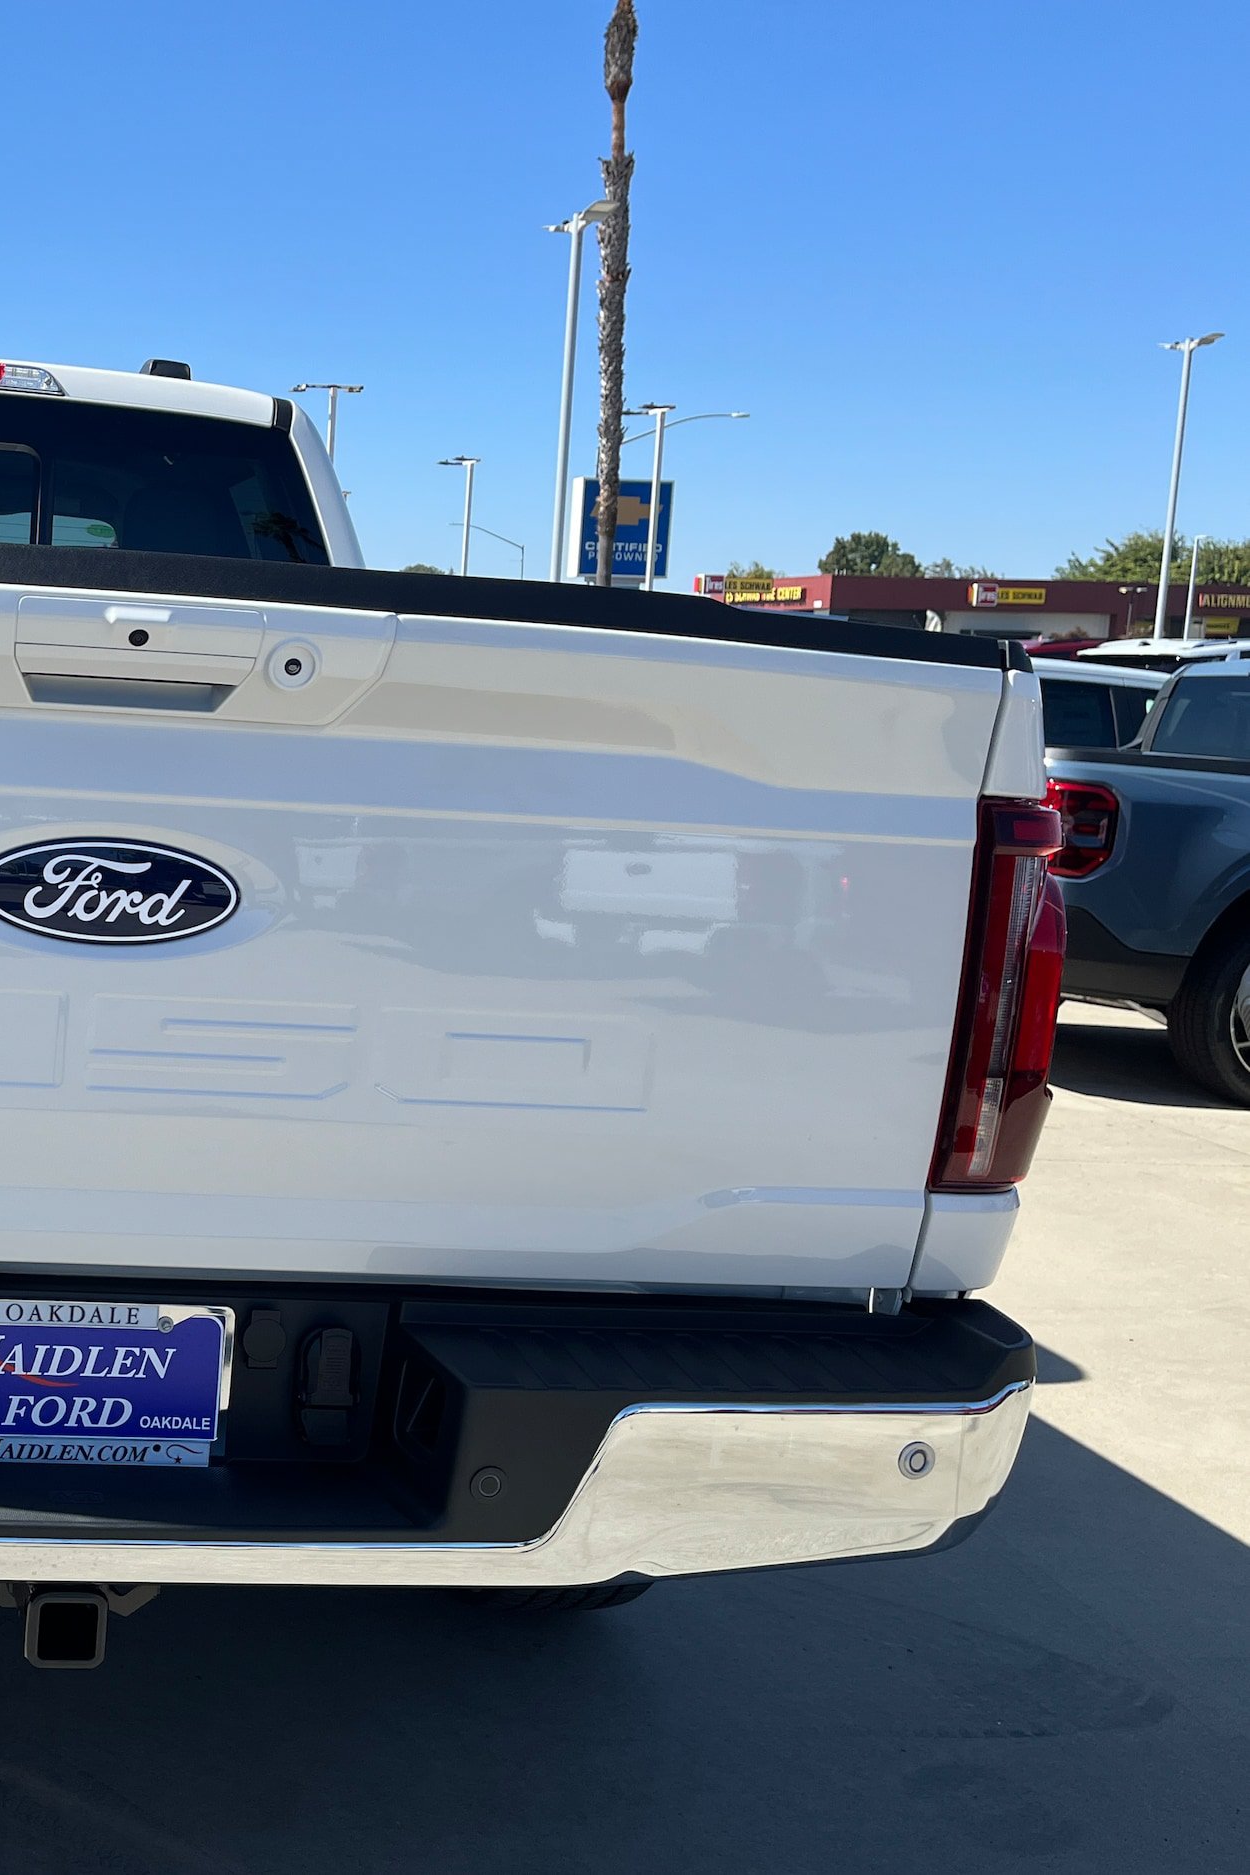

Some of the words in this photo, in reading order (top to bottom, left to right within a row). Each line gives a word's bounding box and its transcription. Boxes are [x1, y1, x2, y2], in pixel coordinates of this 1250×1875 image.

[585, 541, 663, 553] CTIFID
[23, 854, 193, 926] Ford
[6, 1302, 140, 1326] OAKDALE
[0, 1395, 133, 1428] FORD
[139, 1416, 211, 1431] OAKDALE
